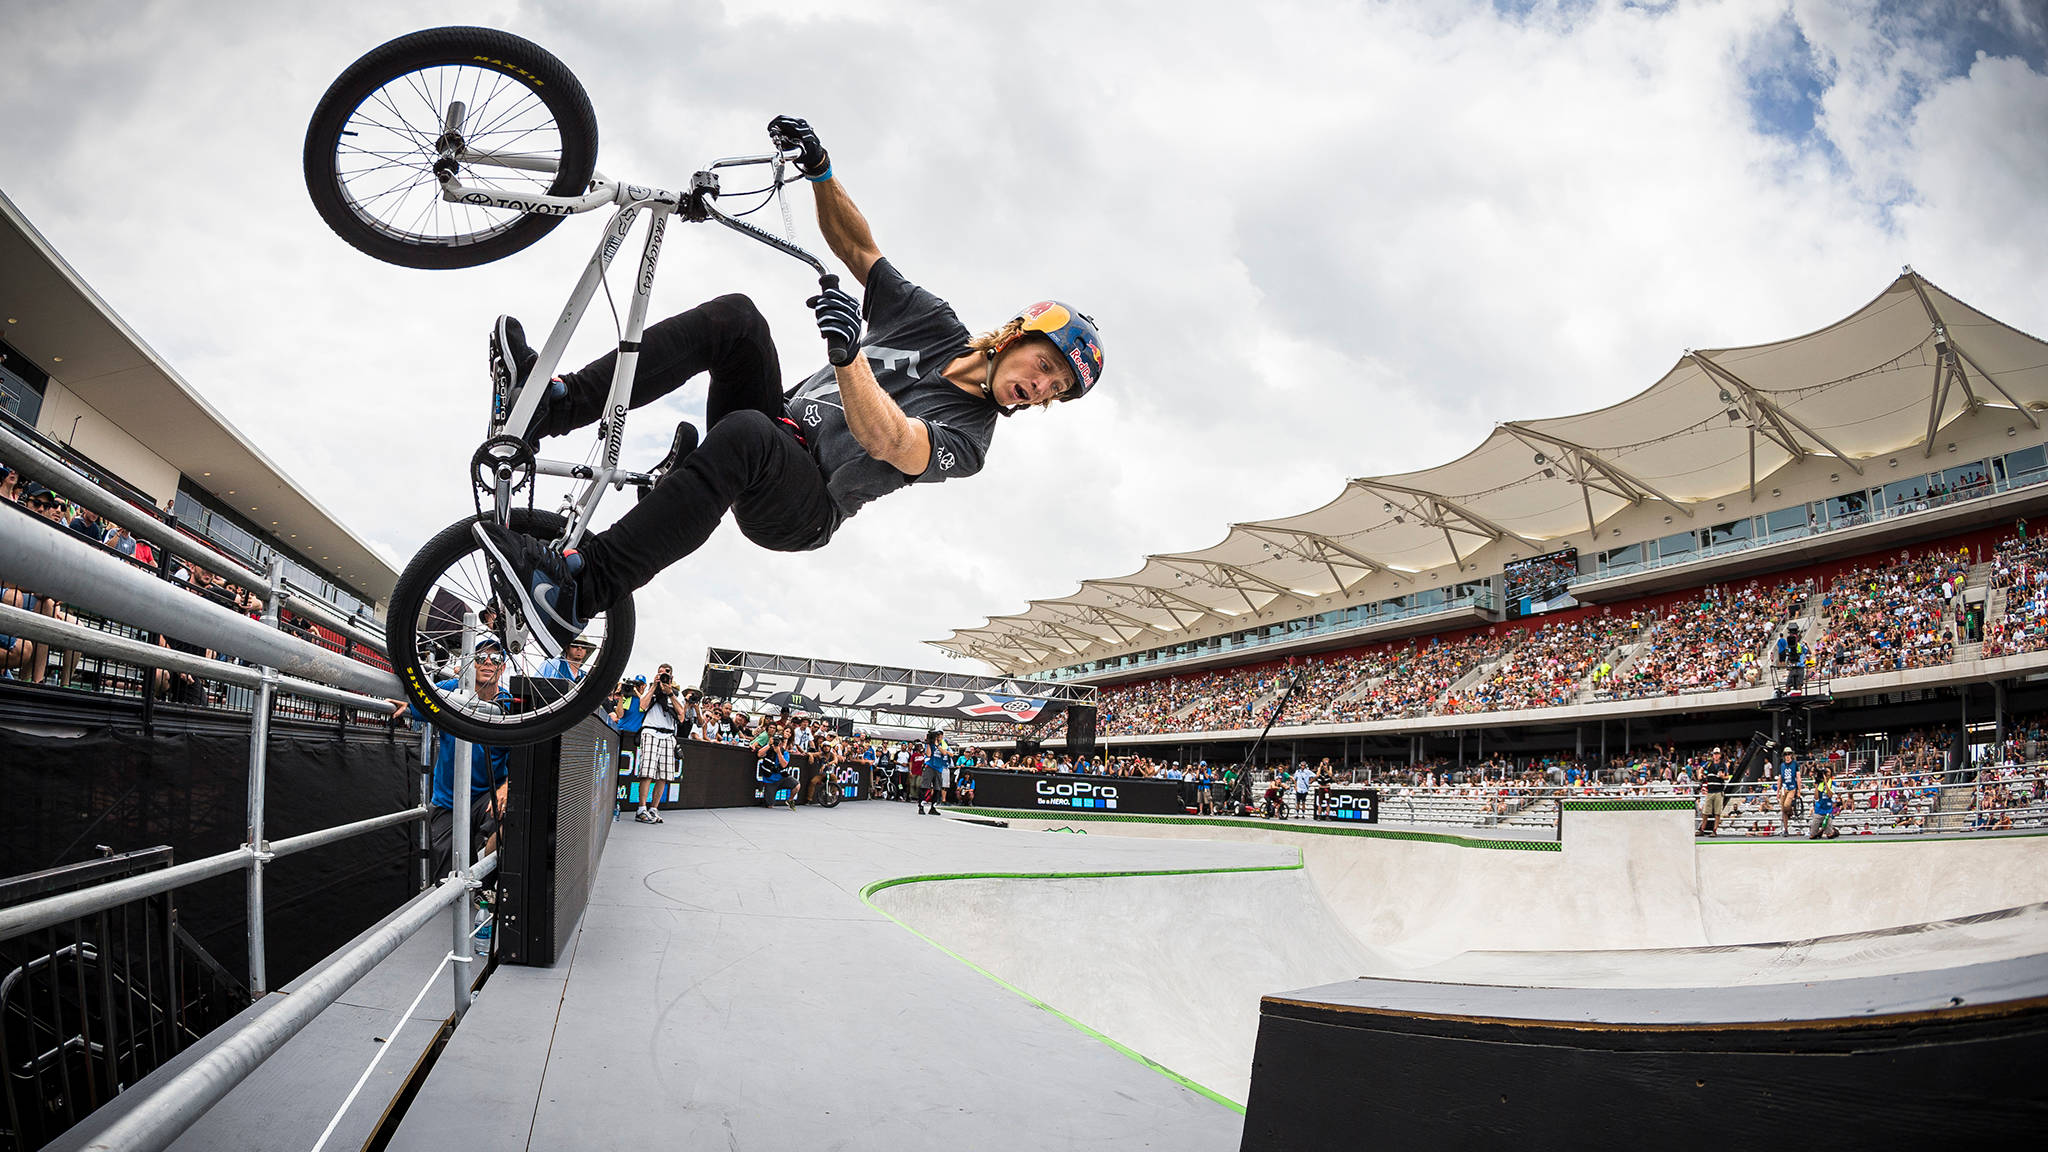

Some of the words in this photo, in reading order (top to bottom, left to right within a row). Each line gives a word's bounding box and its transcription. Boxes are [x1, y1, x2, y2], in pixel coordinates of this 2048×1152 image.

[472, 55, 545, 86] MAXXIS
[496, 198, 575, 215] TOYOTA
[608, 404, 628, 466] Shadow
[406, 666, 441, 713] MAXXIS
